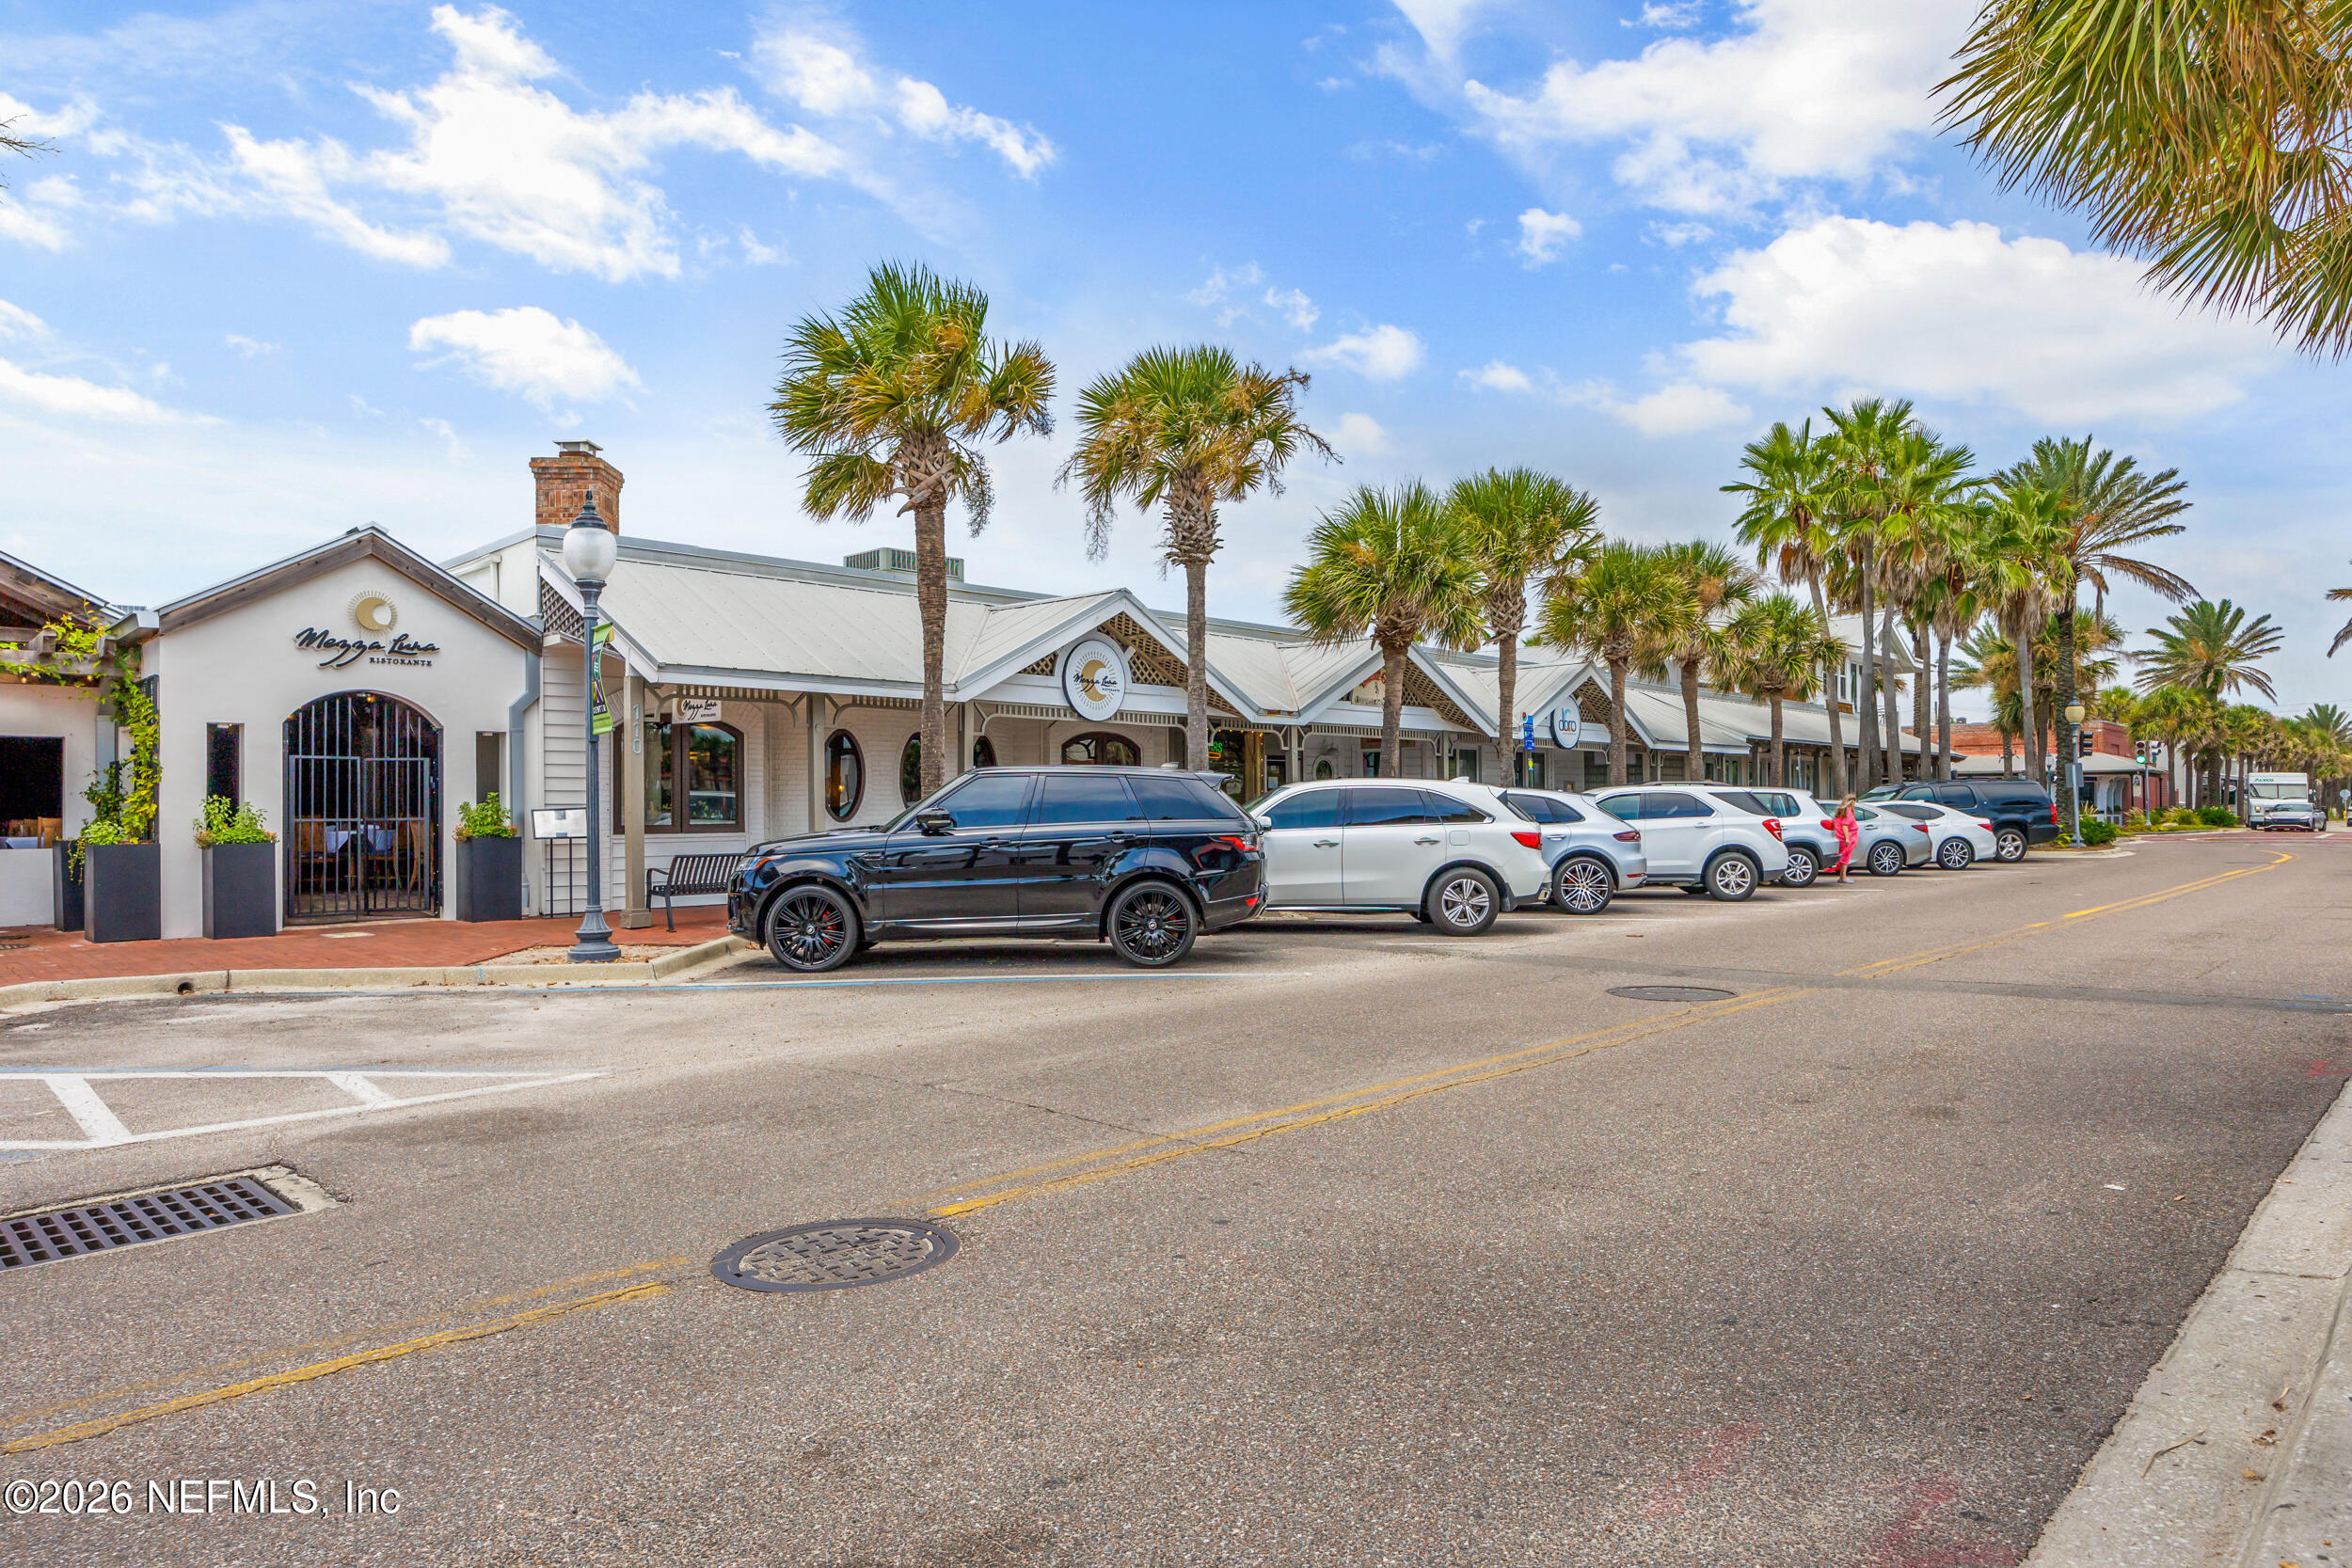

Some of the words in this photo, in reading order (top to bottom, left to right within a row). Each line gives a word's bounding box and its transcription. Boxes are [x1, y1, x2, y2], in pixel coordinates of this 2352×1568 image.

[294, 626, 386, 667] Mezza
[388, 633, 440, 656] Luna
[369, 657, 433, 667] RISTORANTE
[1073, 673, 1101, 693] Mezza
[1101, 675, 1118, 688] Luna
[632, 704, 643, 754] 110
